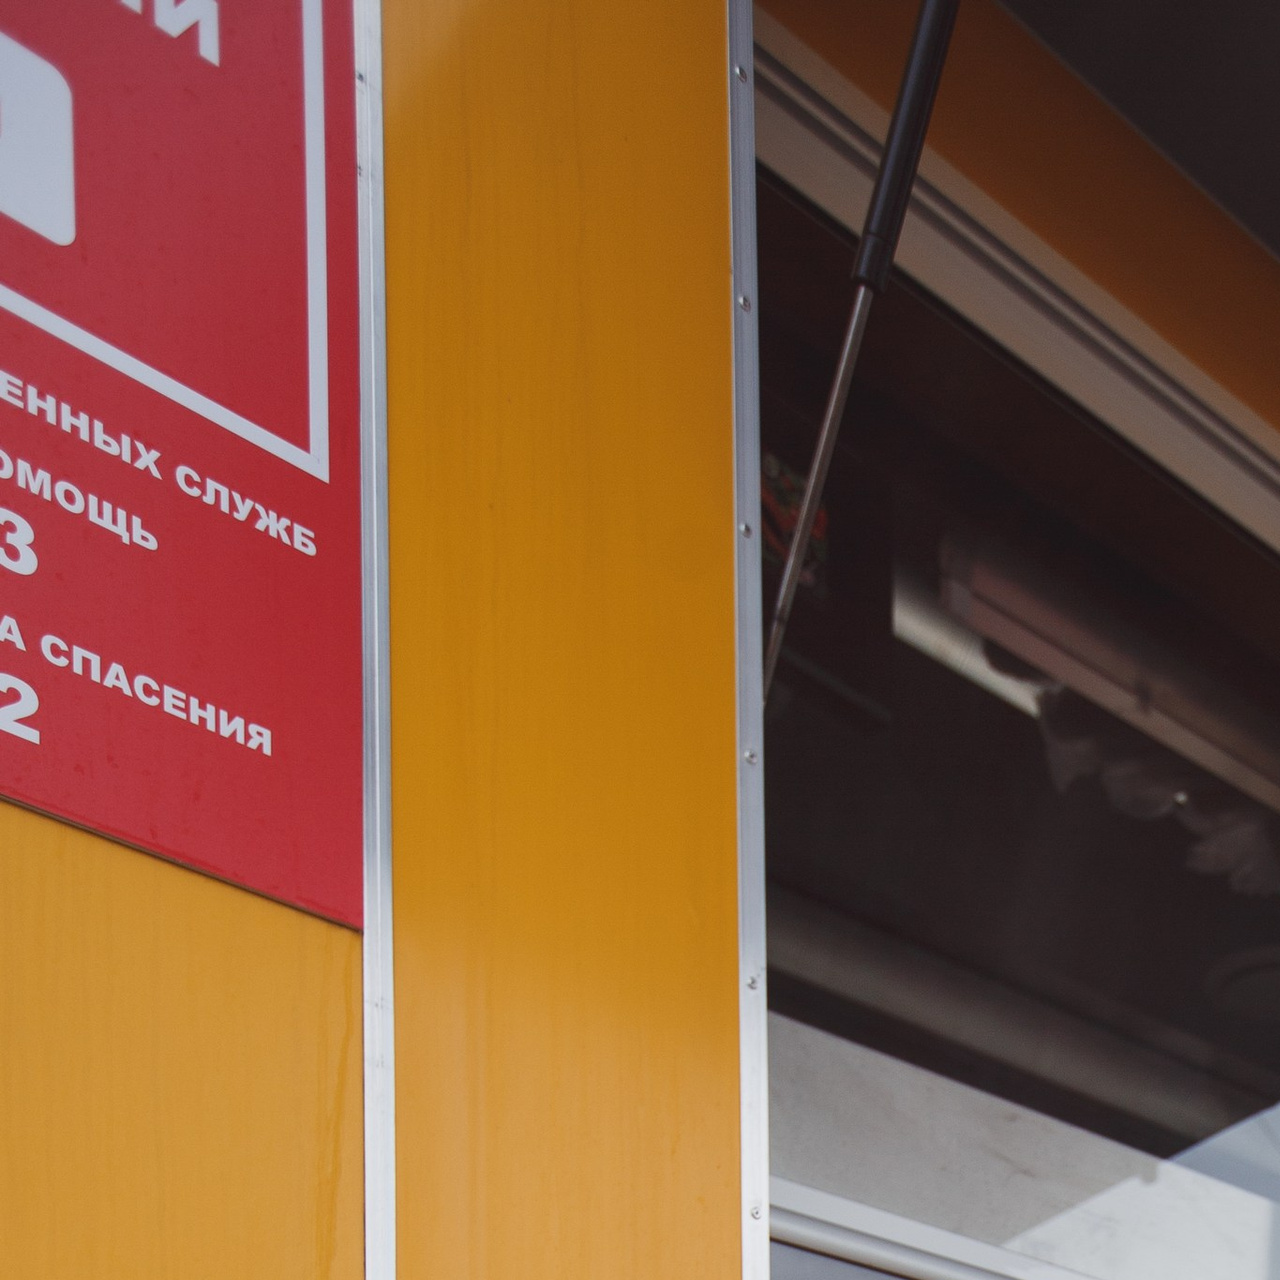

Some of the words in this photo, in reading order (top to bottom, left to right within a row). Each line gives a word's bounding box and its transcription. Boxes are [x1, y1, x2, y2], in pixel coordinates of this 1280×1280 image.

[0, 370, 163, 480] ЕННЫХ
[176, 464, 317, 557] СЛУЖБ
[41, 634, 272, 756] СПАСЕНИЯ
